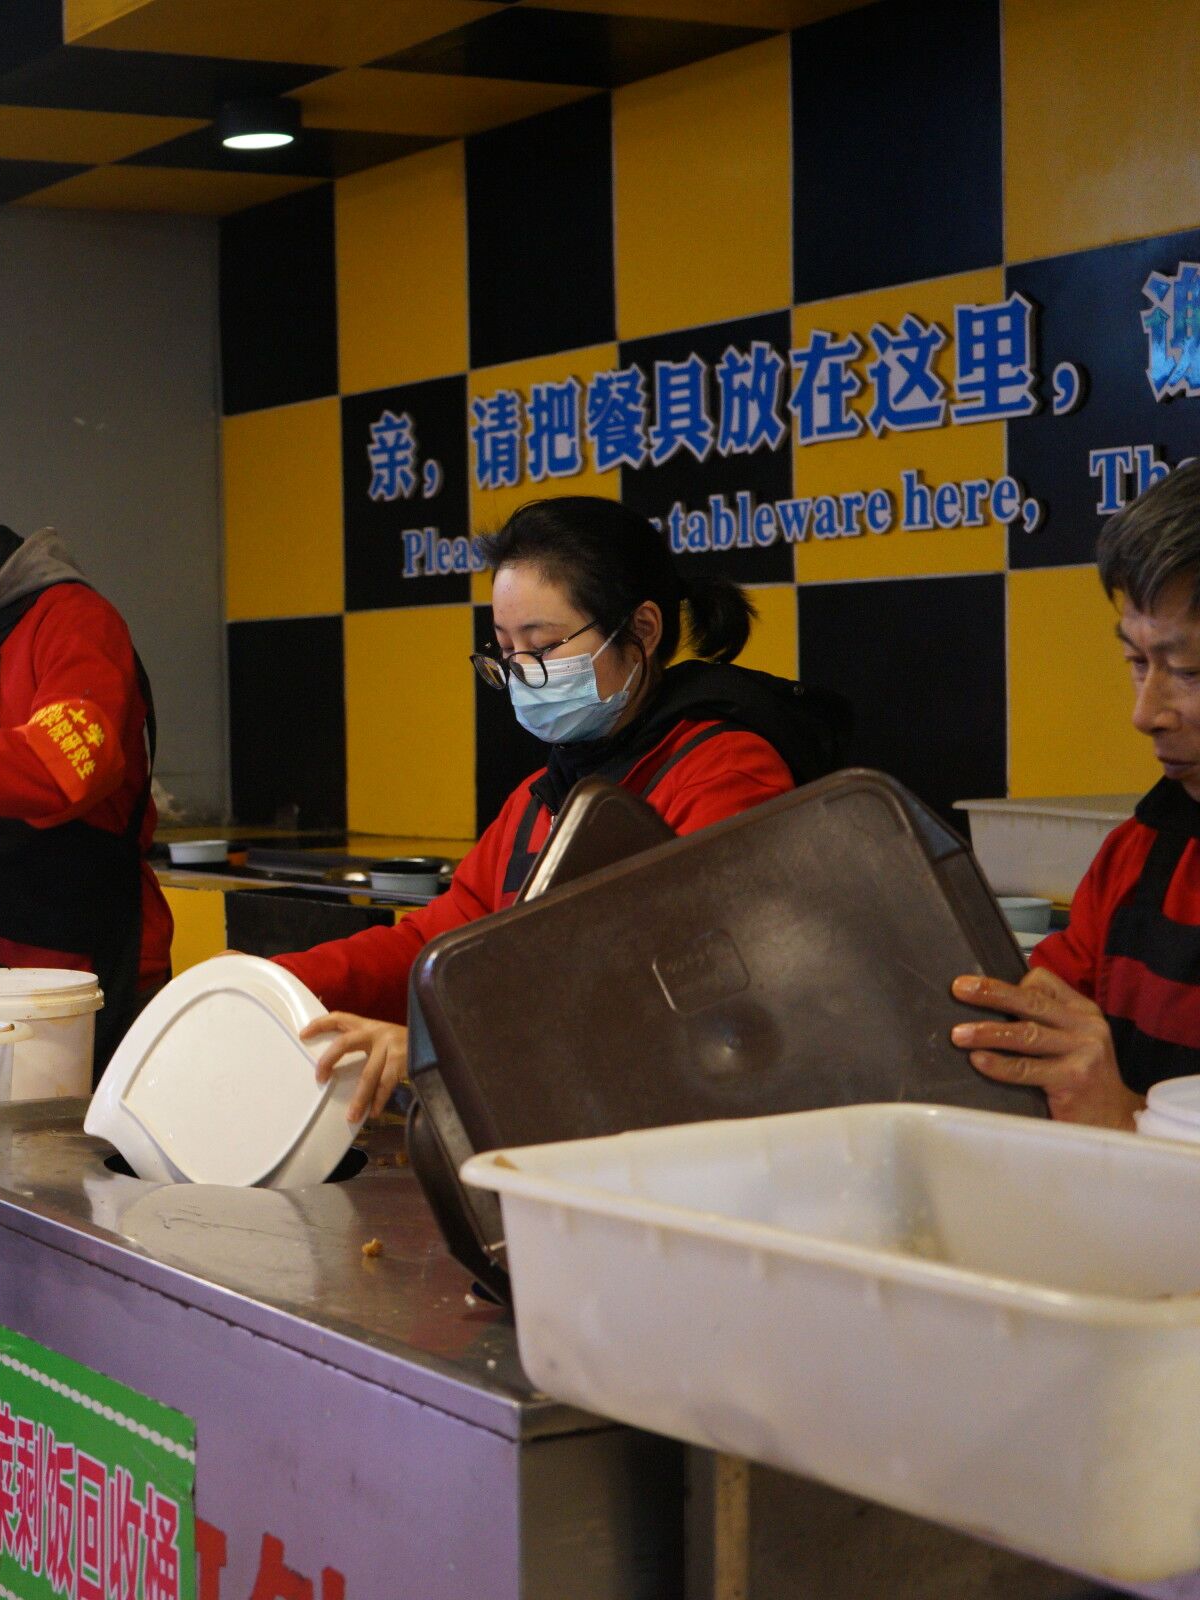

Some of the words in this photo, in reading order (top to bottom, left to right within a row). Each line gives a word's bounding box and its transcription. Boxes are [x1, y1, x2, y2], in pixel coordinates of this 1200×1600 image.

[402, 526, 494, 579] Pleas
[668, 490, 894, 555] tableware
[900, 467, 1041, 534] here,
